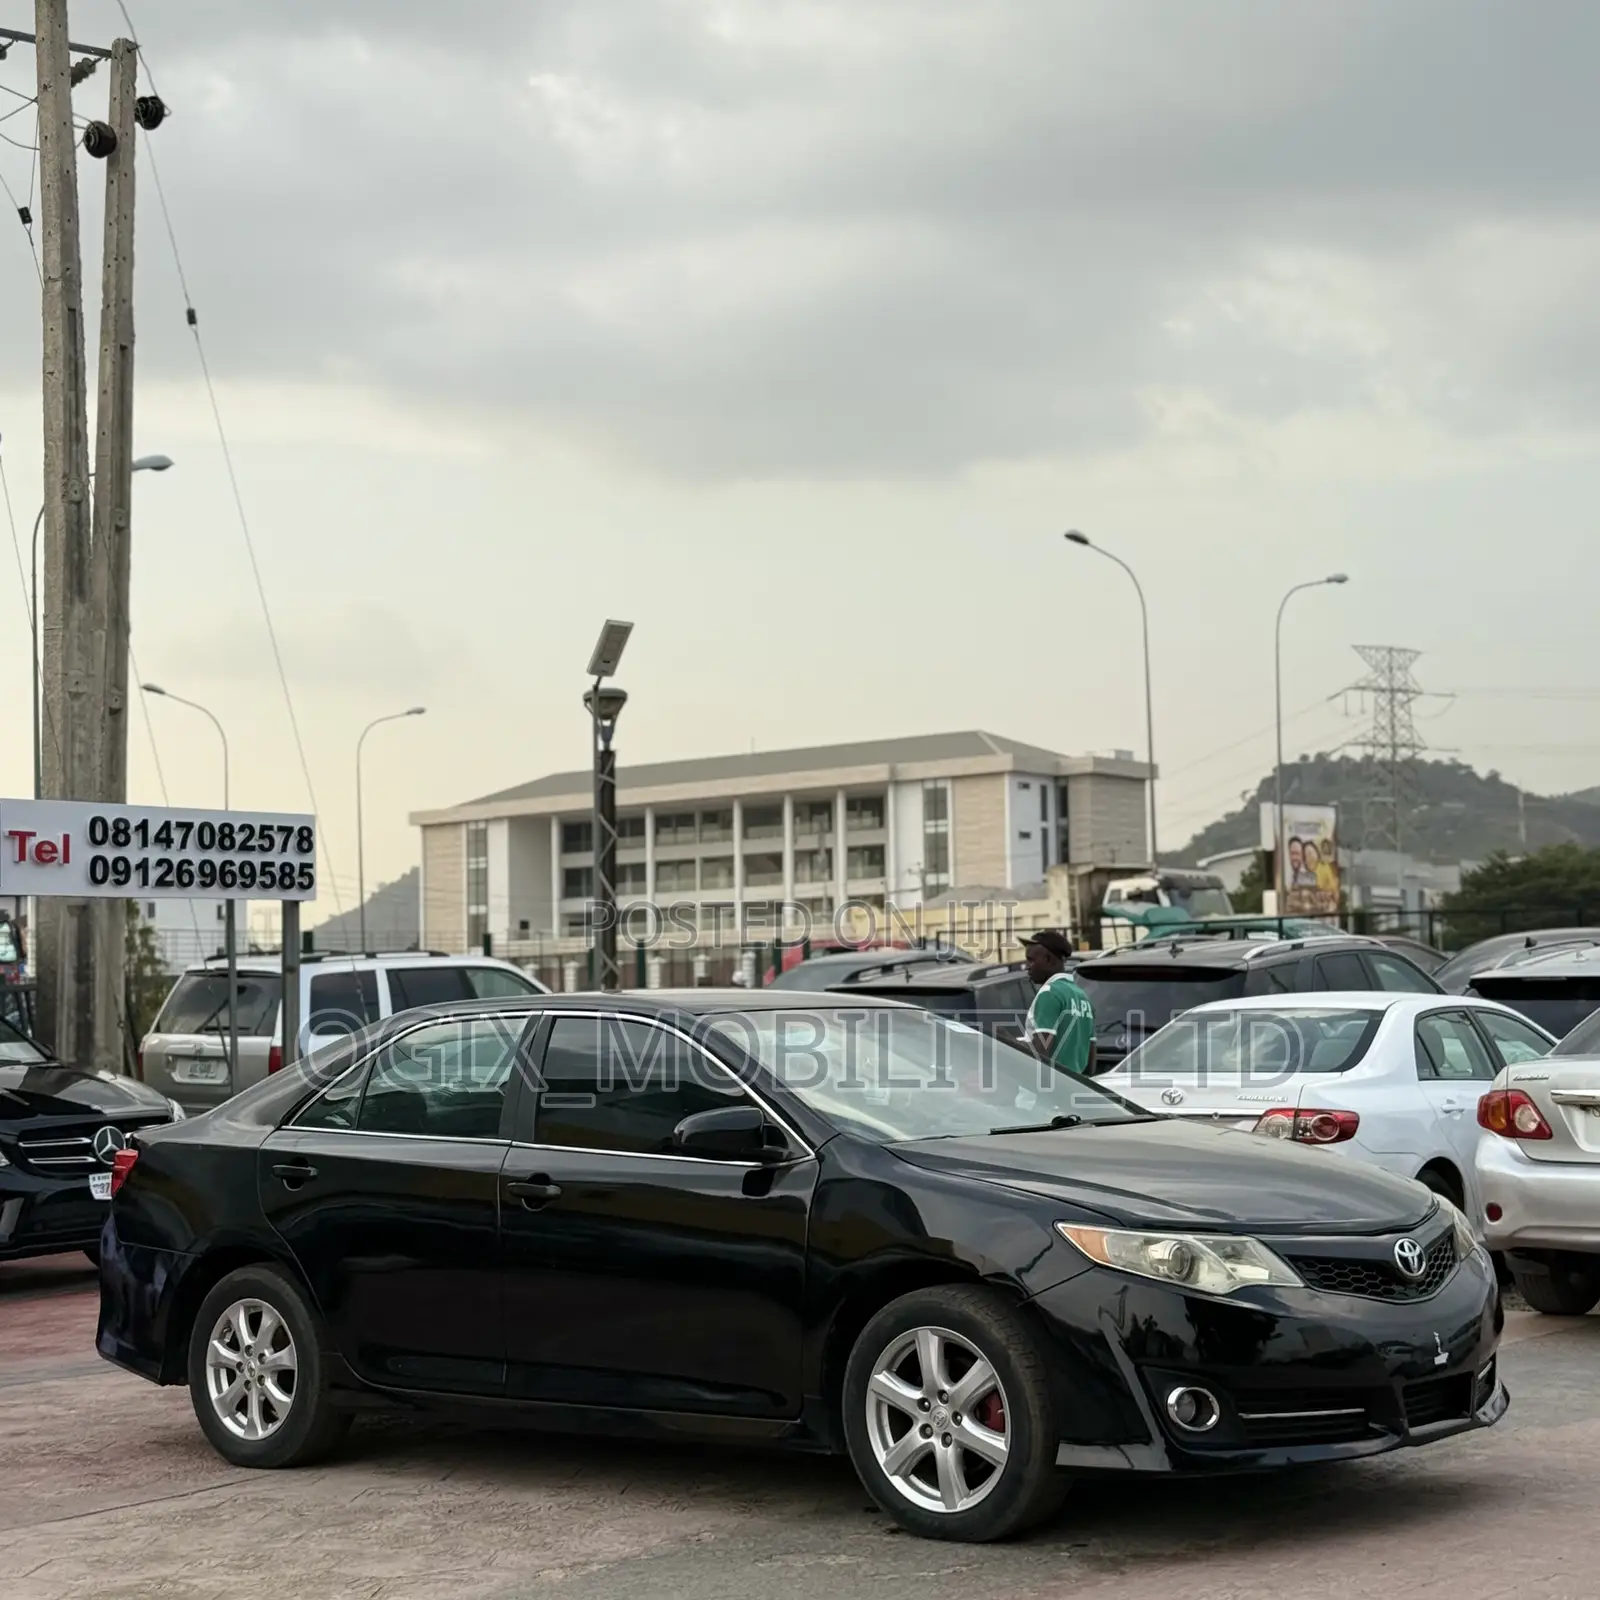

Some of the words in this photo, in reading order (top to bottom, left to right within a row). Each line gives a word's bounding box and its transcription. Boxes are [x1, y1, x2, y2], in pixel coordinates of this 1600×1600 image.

[7, 829, 70, 865] Tel
[88, 815, 314, 853] 08147082578
[88, 854, 315, 890] 09126969585
